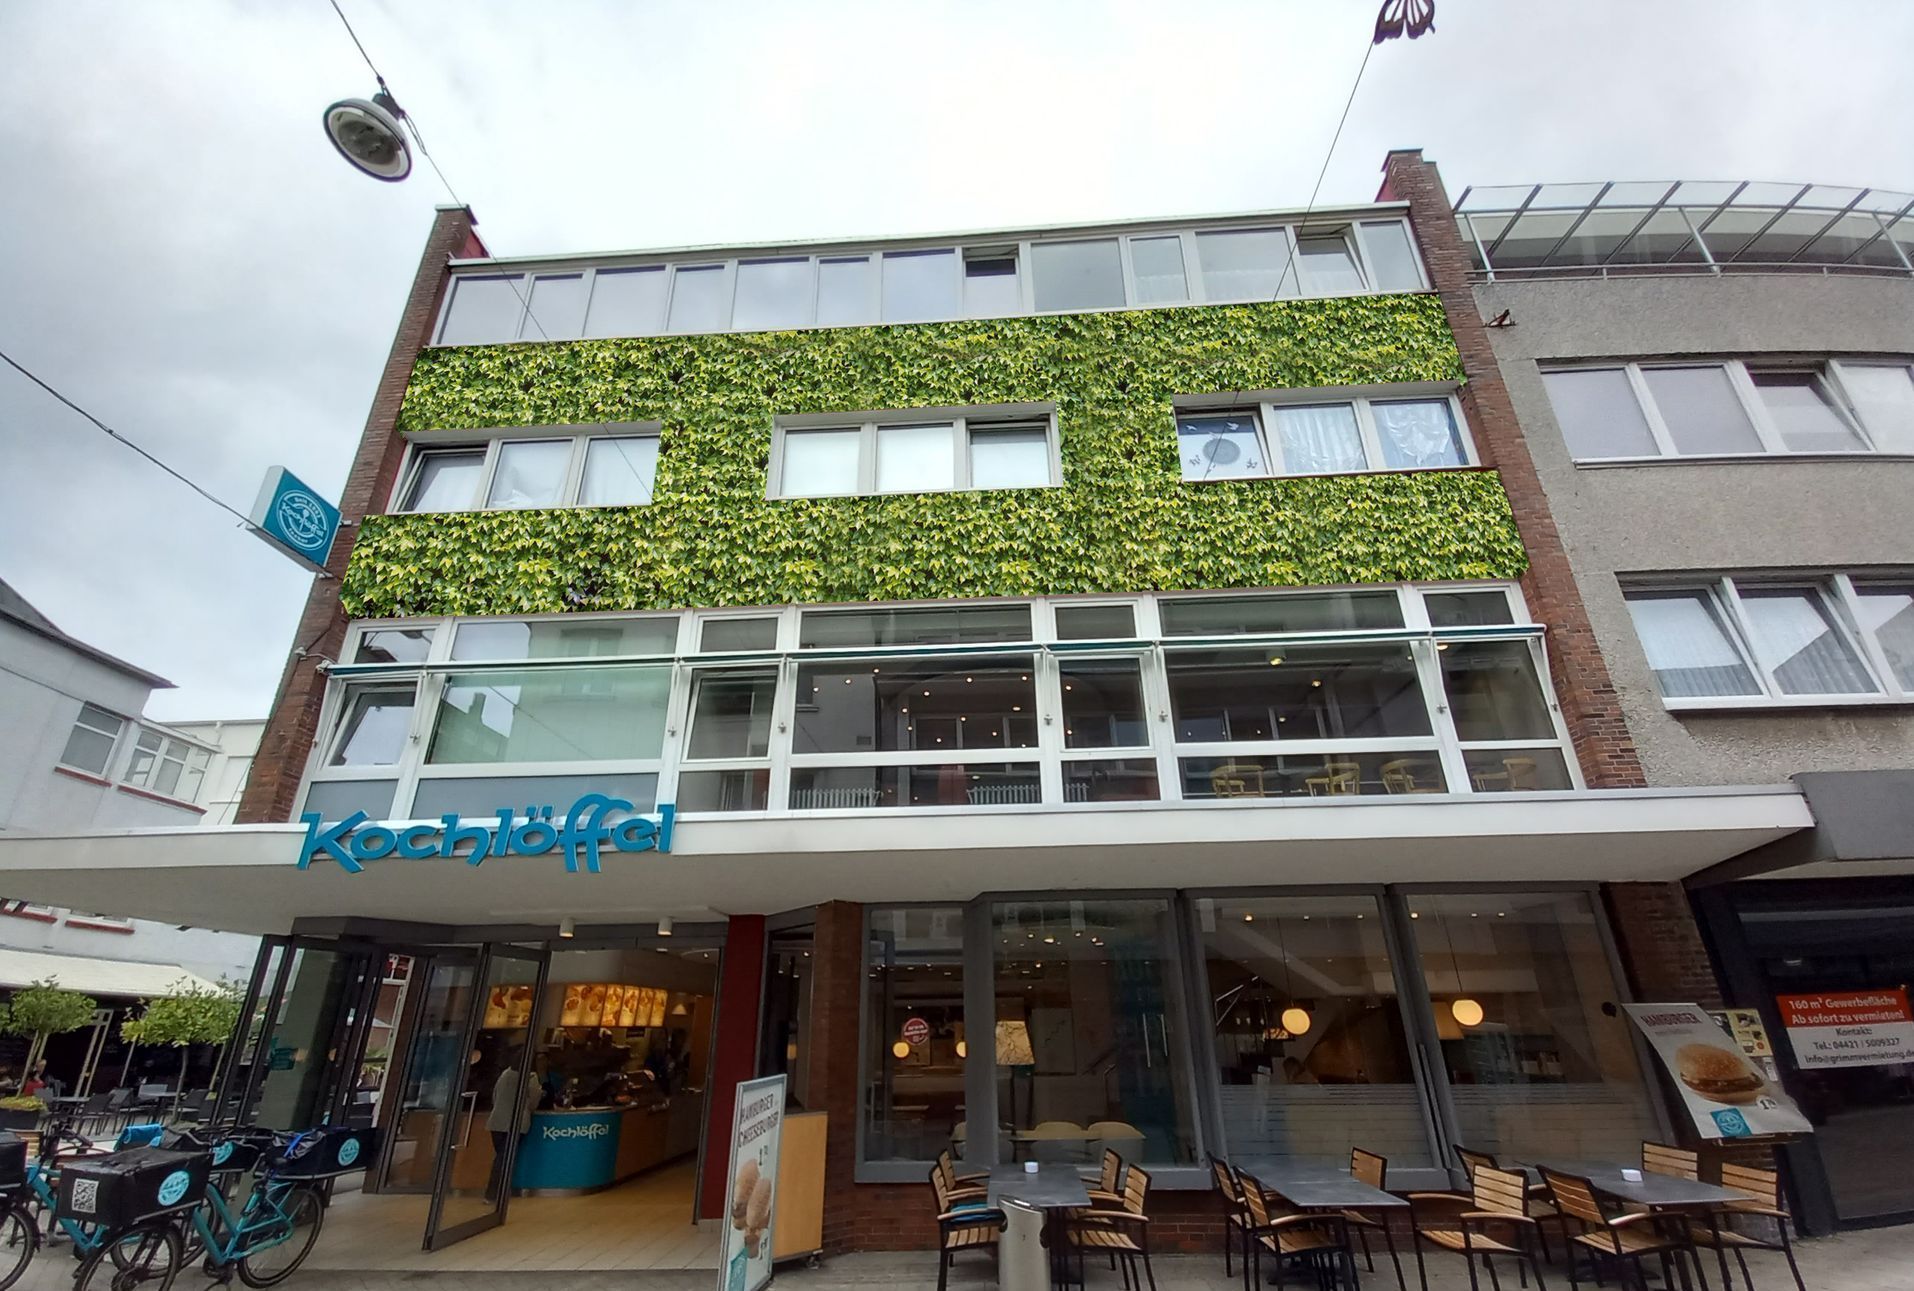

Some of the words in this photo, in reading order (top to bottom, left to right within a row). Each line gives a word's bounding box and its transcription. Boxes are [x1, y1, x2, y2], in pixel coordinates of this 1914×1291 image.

[297, 793, 676, 873] Kochlöffel
[1788, 1000, 1809, 1010] 160
[1825, 995, 1897, 1008] Gewerbefläche
[1791, 1014, 1806, 1025] Ab
[1807, 1012, 1839, 1024] sofort
[1840, 1014, 1853, 1023] zu
[1853, 1009, 1905, 1021] vermieten!
[1834, 1026, 1873, 1037] Kontakt:
[543, 1123, 609, 1141] Kochlöffel
